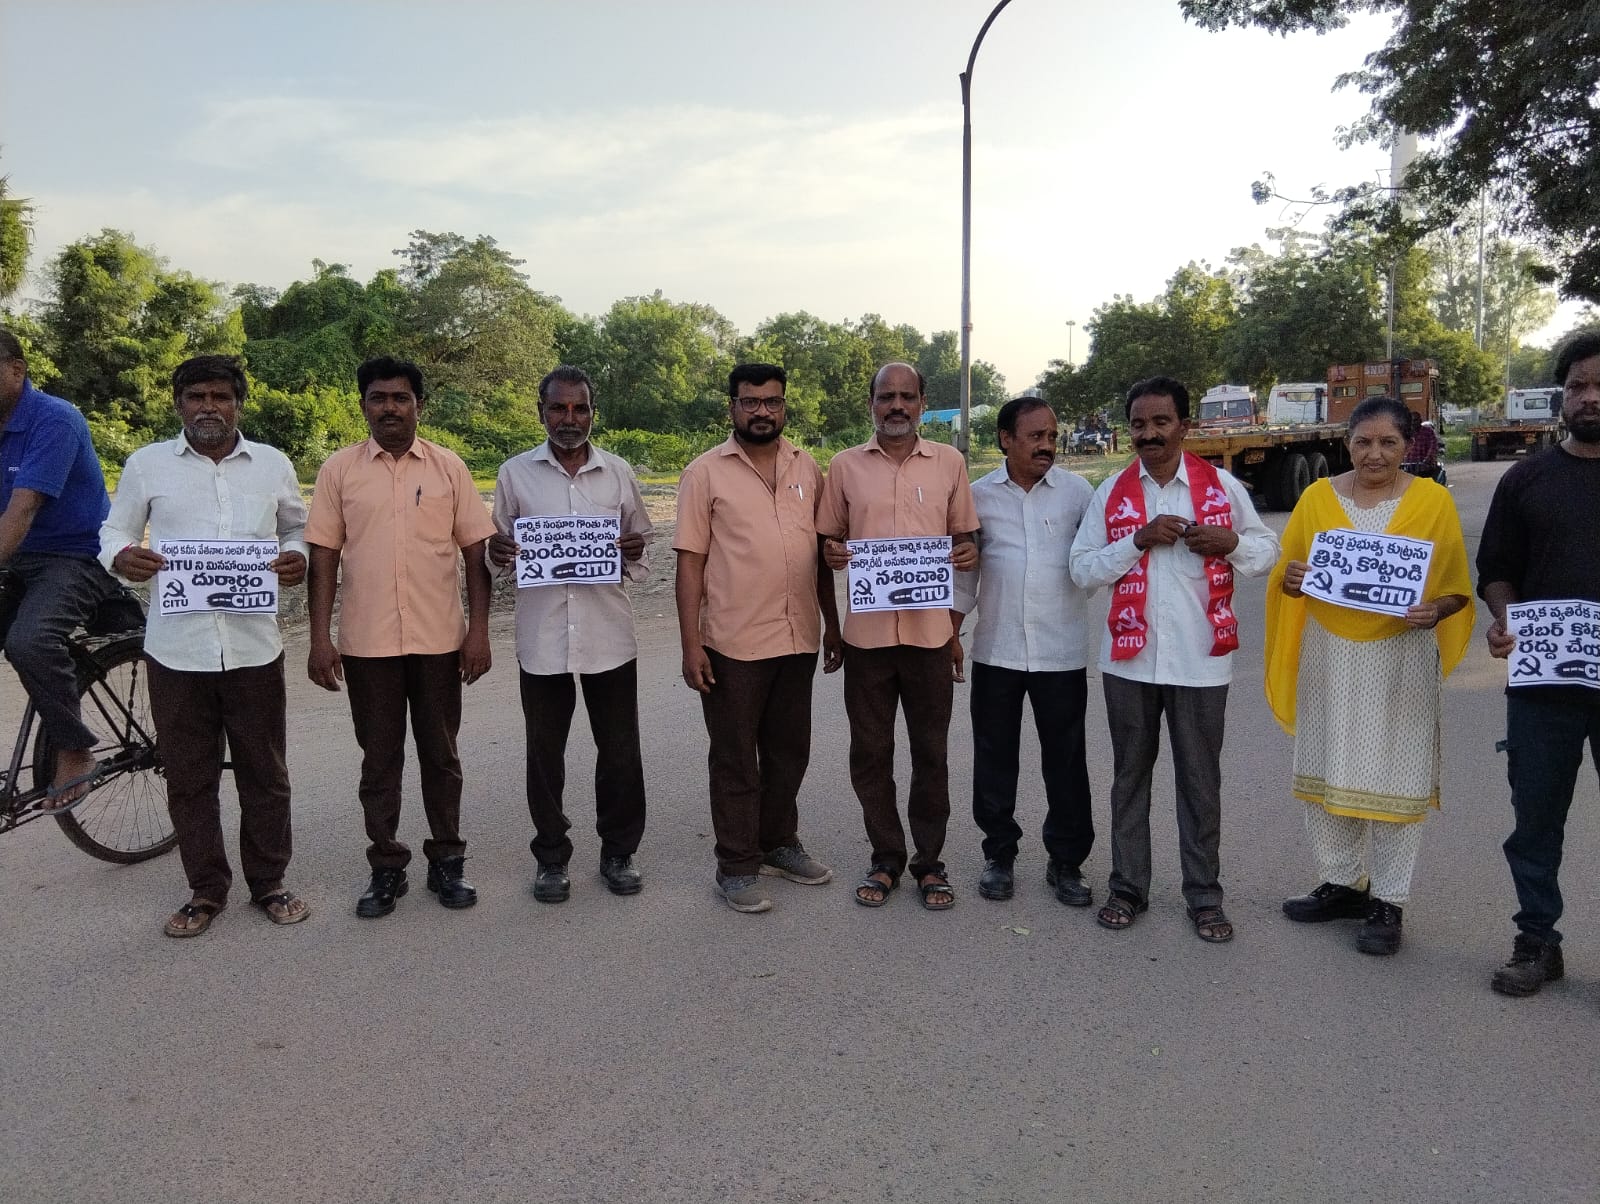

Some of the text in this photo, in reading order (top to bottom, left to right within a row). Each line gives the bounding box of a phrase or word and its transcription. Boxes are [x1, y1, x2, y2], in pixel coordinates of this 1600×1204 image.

[517, 521, 541, 531] కార్మిక
[577, 520, 601, 528] గొంతు
[1204, 512, 1233, 526] CIT
[521, 532, 615, 543] కేంద్ర ప్రభుత్వ చర్యలను
[520, 543, 618, 563] ఖండించండి
[899, 542, 921, 553] కార్మిక
[1346, 538, 1384, 557] ప్రభుత్వ
[1387, 543, 1428, 560] కుట్రను
[884, 557, 918, 567] అనుకూల
[876, 567, 949, 585] నశించాలి
[1356, 556, 1423, 583] కొట్టండి
[192, 572, 263, 592] దుర్మార్గం
[1119, 581, 1144, 595] CITU
[163, 599, 188, 608] CITU
[853, 596, 875, 605] CITU
[1511, 606, 1547, 622] కార్మిక
[1550, 604, 1591, 621] వ్యతిరేక
[1519, 623, 1564, 637] లేబర్
[1118, 635, 1144, 648] CITU
[1519, 640, 1558, 660] రద్దు
